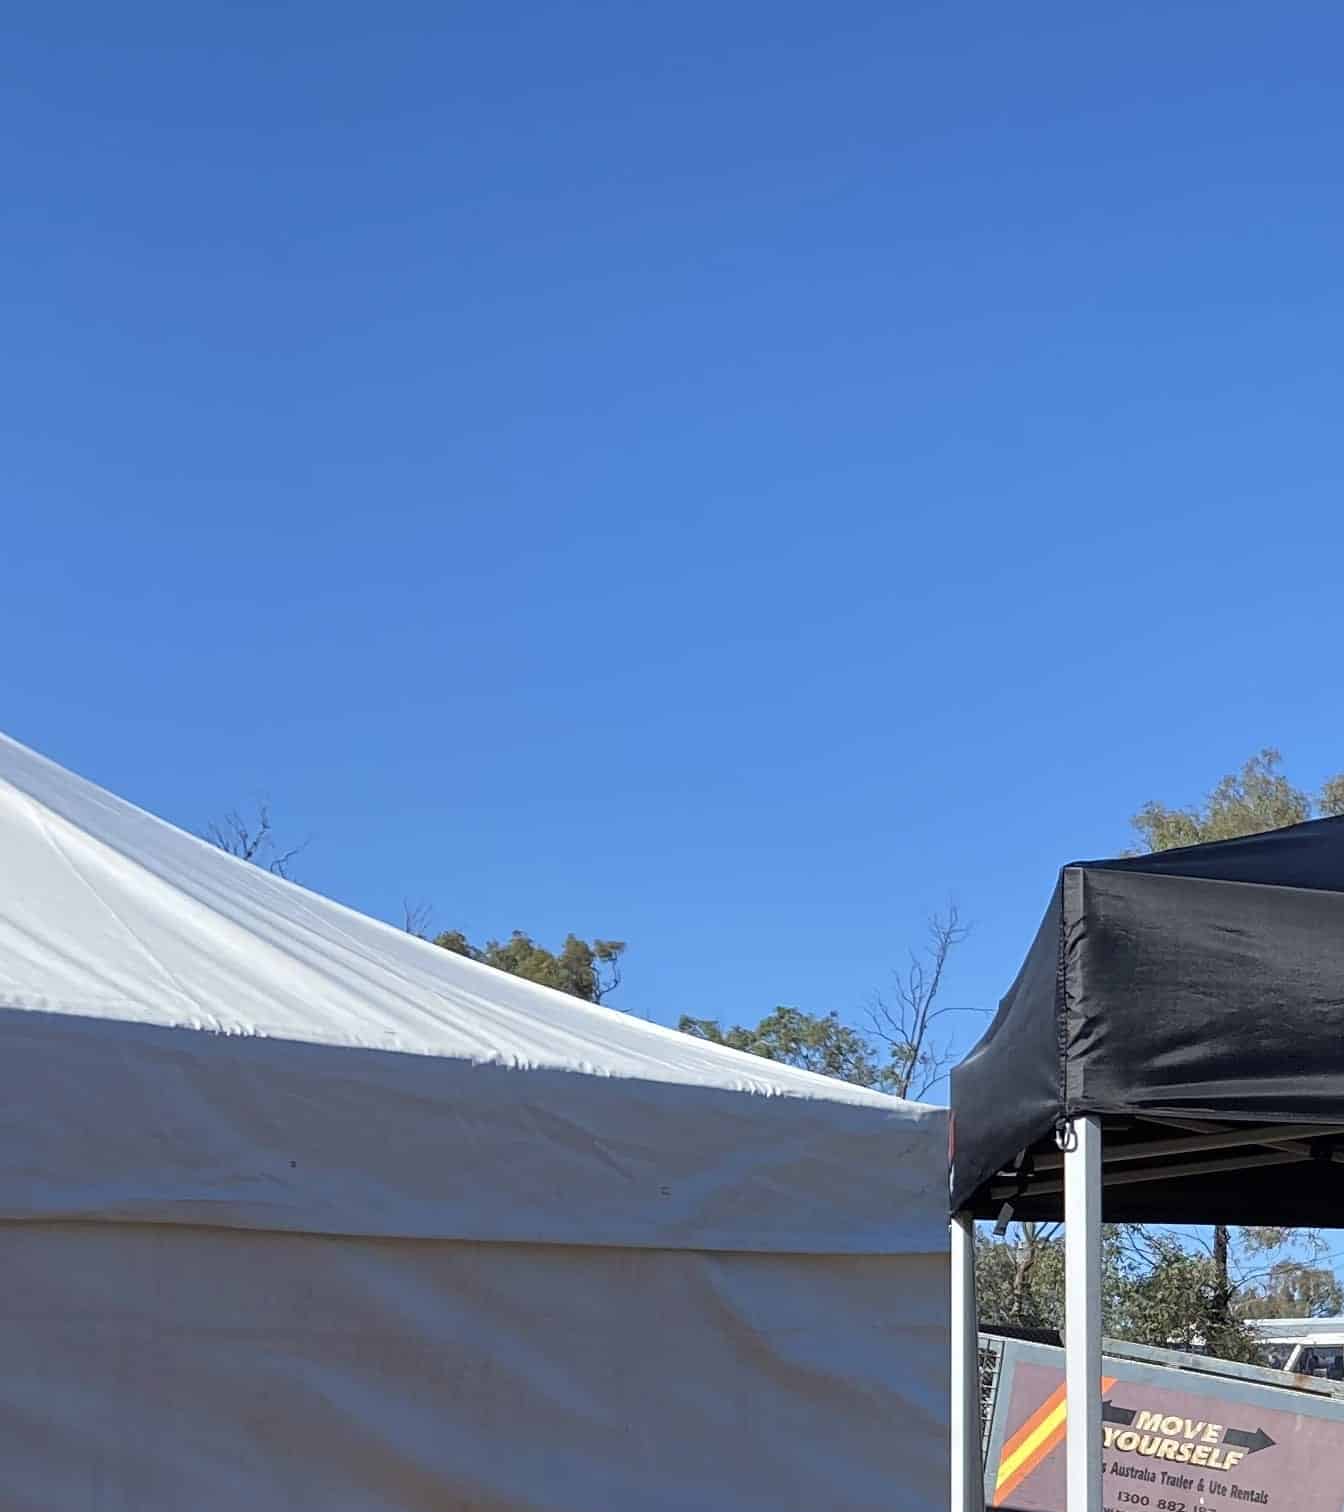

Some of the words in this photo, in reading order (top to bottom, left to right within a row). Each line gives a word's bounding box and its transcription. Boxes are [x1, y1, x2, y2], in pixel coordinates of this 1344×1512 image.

[1136, 1410, 1223, 1443] MOVE
[1103, 1427, 1244, 1472] YOURSELF
[1110, 1462, 1156, 1483] Australia
[1161, 1472, 1194, 1490] Trailer
[1197, 1478, 1205, 1492] &
[1209, 1480, 1227, 1496] Ute
[1230, 1485, 1269, 1504] Rentals
[1118, 1491, 1150, 1506] 1300
